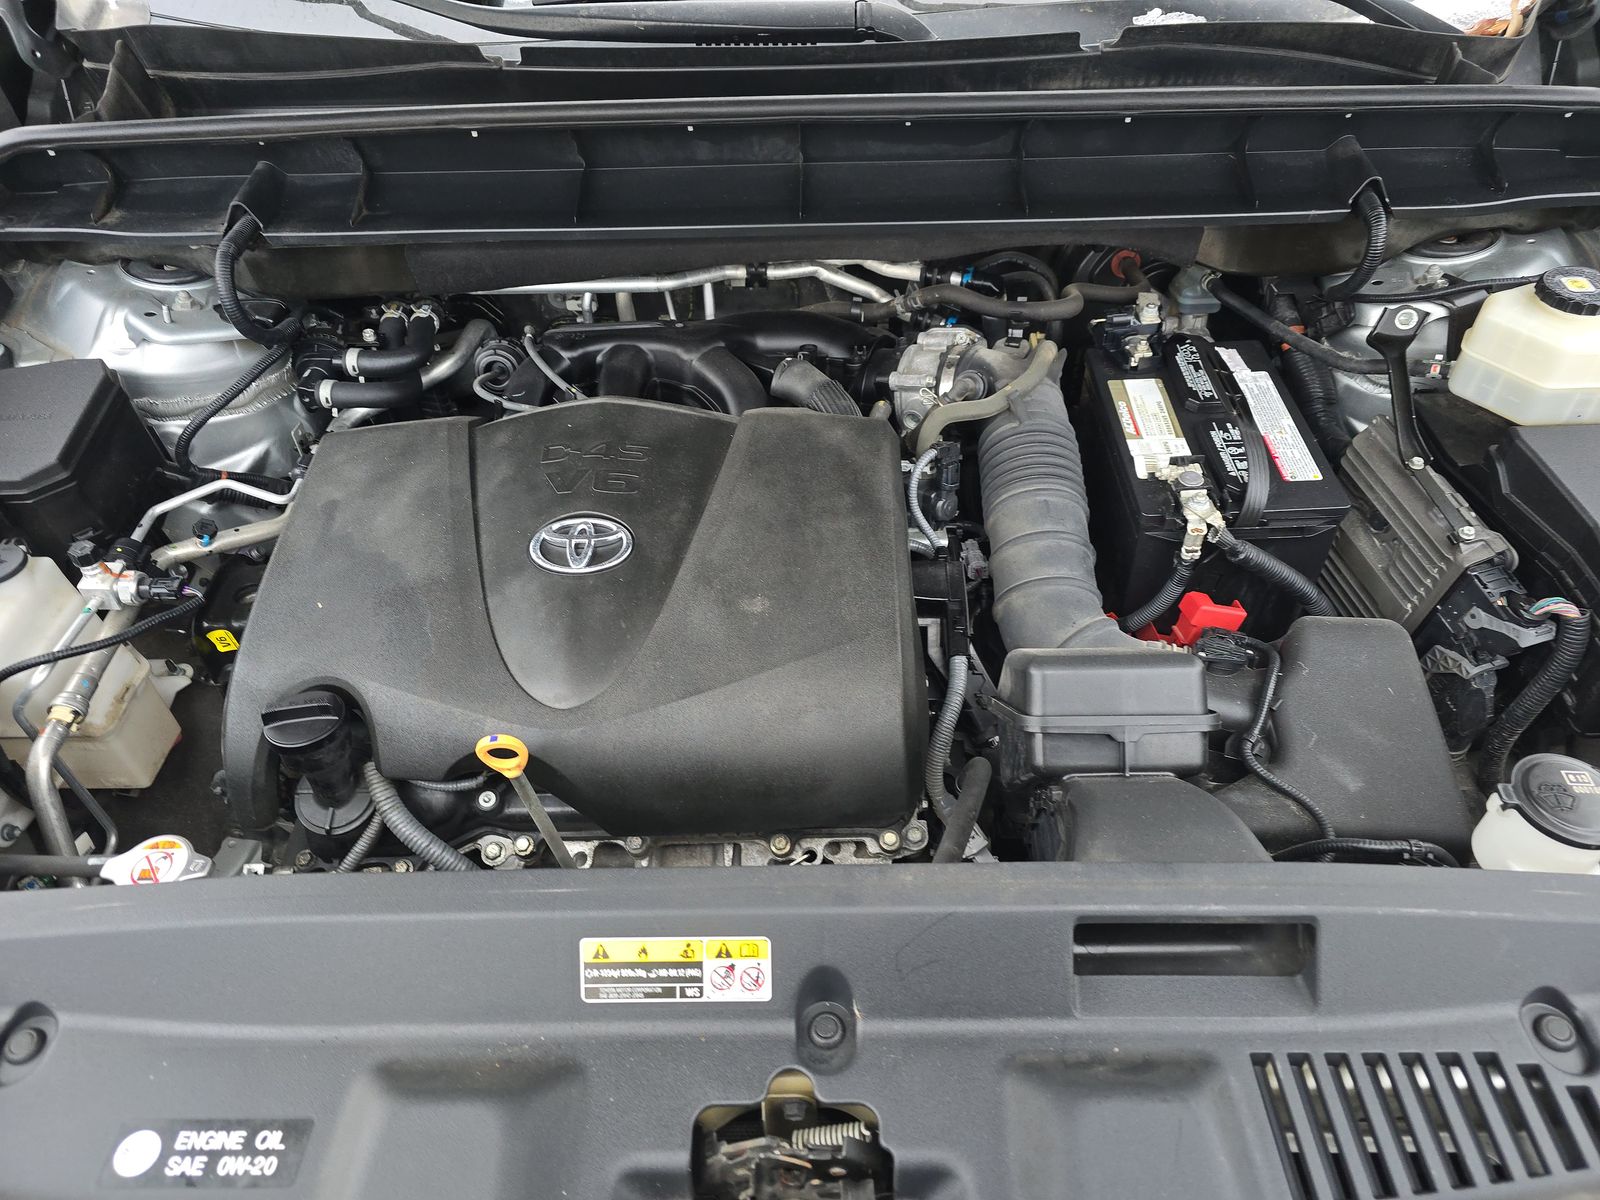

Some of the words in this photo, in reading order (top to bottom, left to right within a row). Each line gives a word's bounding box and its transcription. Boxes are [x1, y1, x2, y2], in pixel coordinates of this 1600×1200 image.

[1118, 401, 1137, 437] ACDelco
[543, 469, 640, 495] V6
[216, 636, 231, 648] V6
[173, 1130, 248, 1151] ENGINE
[254, 1129, 286, 1151] OIL
[164, 1155, 209, 1177] SAE
[216, 1155, 279, 1177] 0W-20
